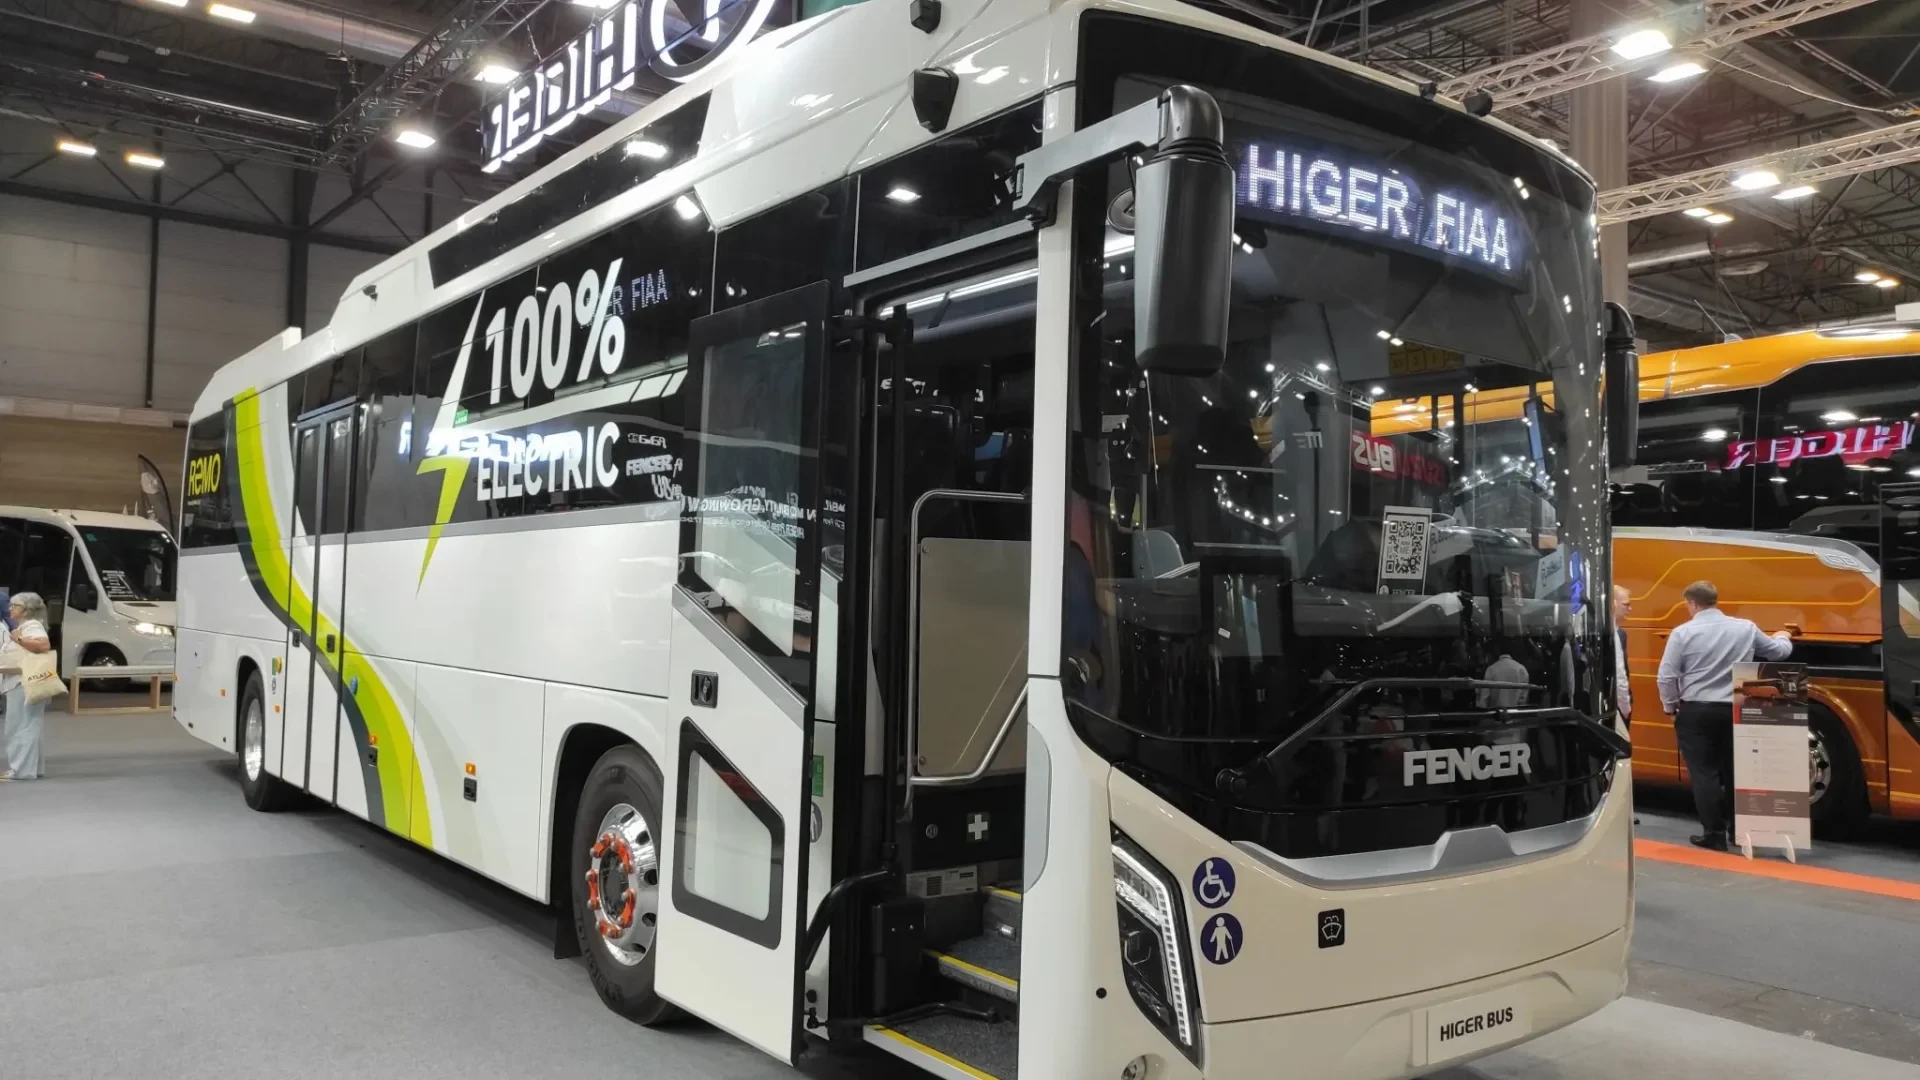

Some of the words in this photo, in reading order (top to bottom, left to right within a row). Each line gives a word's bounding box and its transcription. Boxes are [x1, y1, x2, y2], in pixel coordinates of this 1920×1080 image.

[1248, 144, 1410, 237] HIGER
[1435, 193, 1511, 270] FIAA
[631, 269, 669, 312] FIAA
[484, 257, 626, 405] 100%
[477, 421, 620, 502] ELECTRIC
[1403, 743, 1532, 787] FENCER
[1440, 1014, 1484, 1042] HIGER
[1486, 1006, 1514, 1029] BUS
